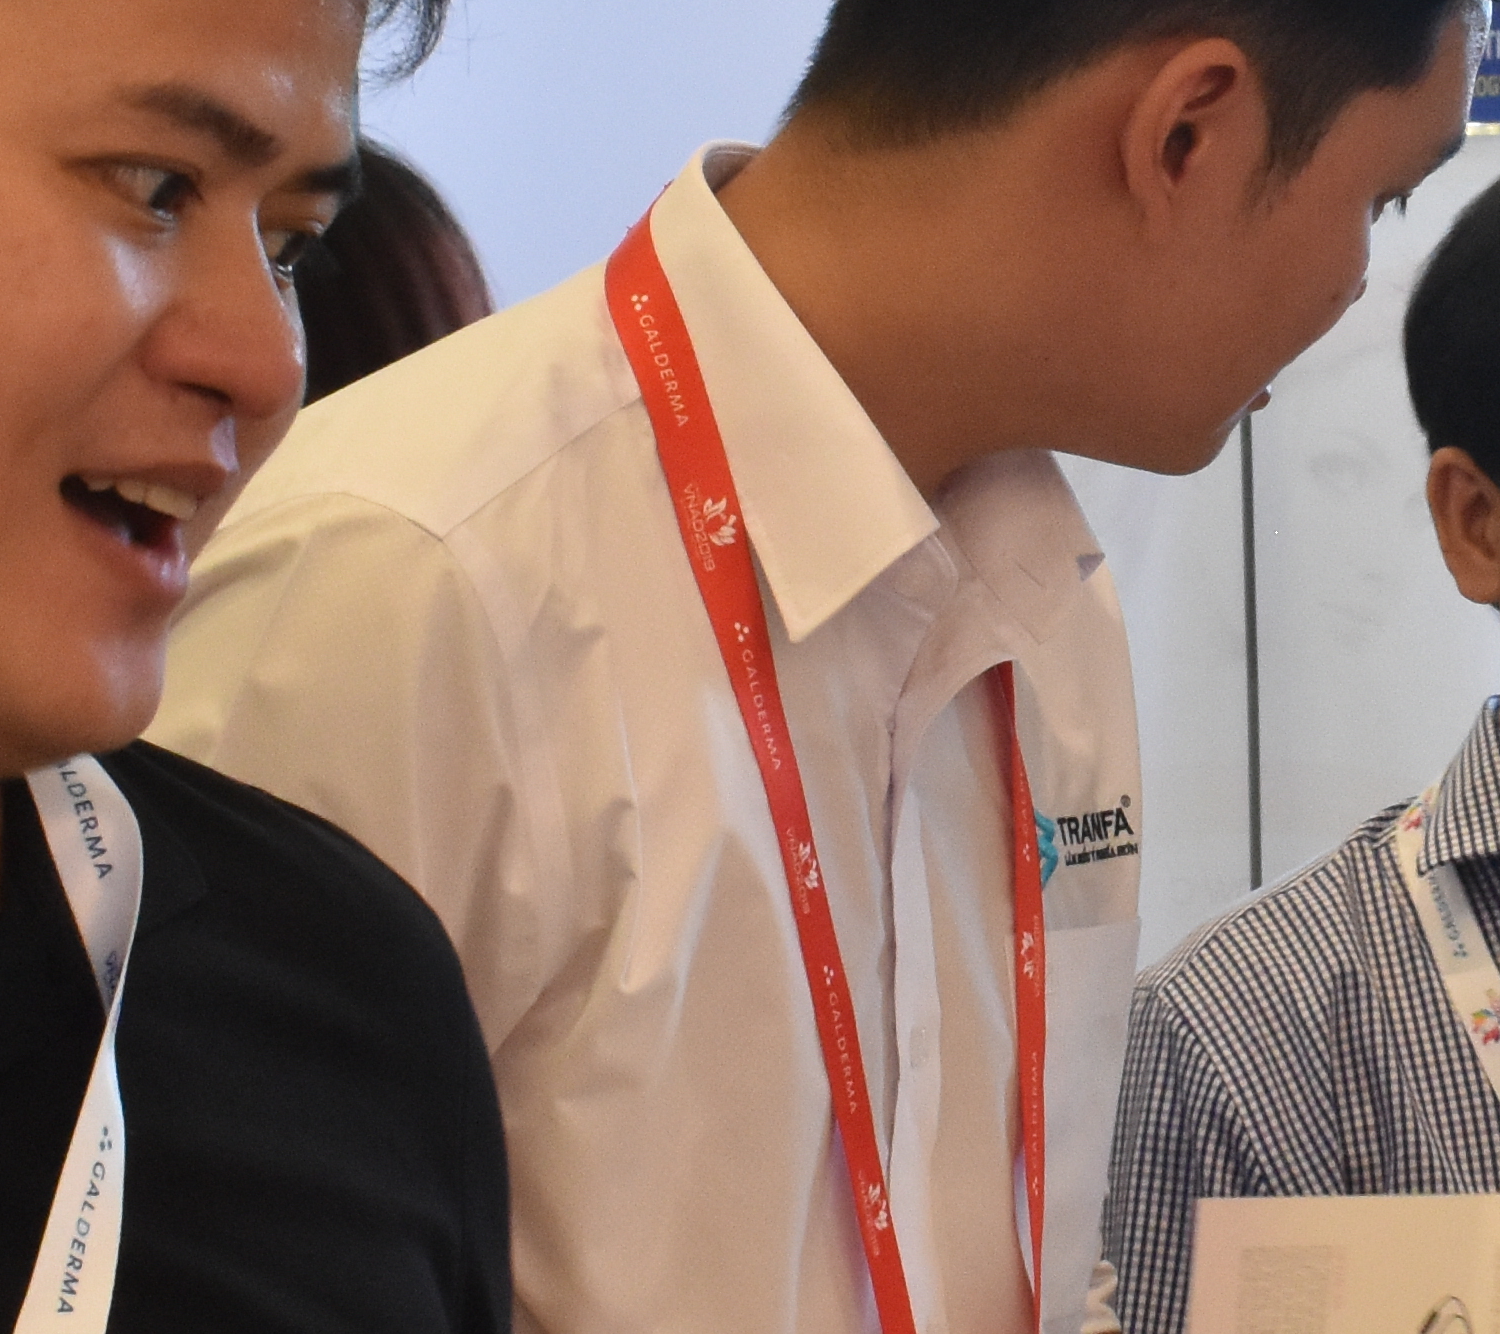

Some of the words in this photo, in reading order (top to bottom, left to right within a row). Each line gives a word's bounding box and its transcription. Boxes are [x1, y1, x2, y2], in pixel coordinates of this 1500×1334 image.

[638, 314, 690, 428] GALDERMA
[741, 648, 782, 771] GALDERMA
[57, 763, 113, 879] LDERMA
[1056, 807, 1135, 847] TRANFA
[828, 990, 858, 1115] GALDERMA
[56, 1160, 107, 1316] GALDERMA
